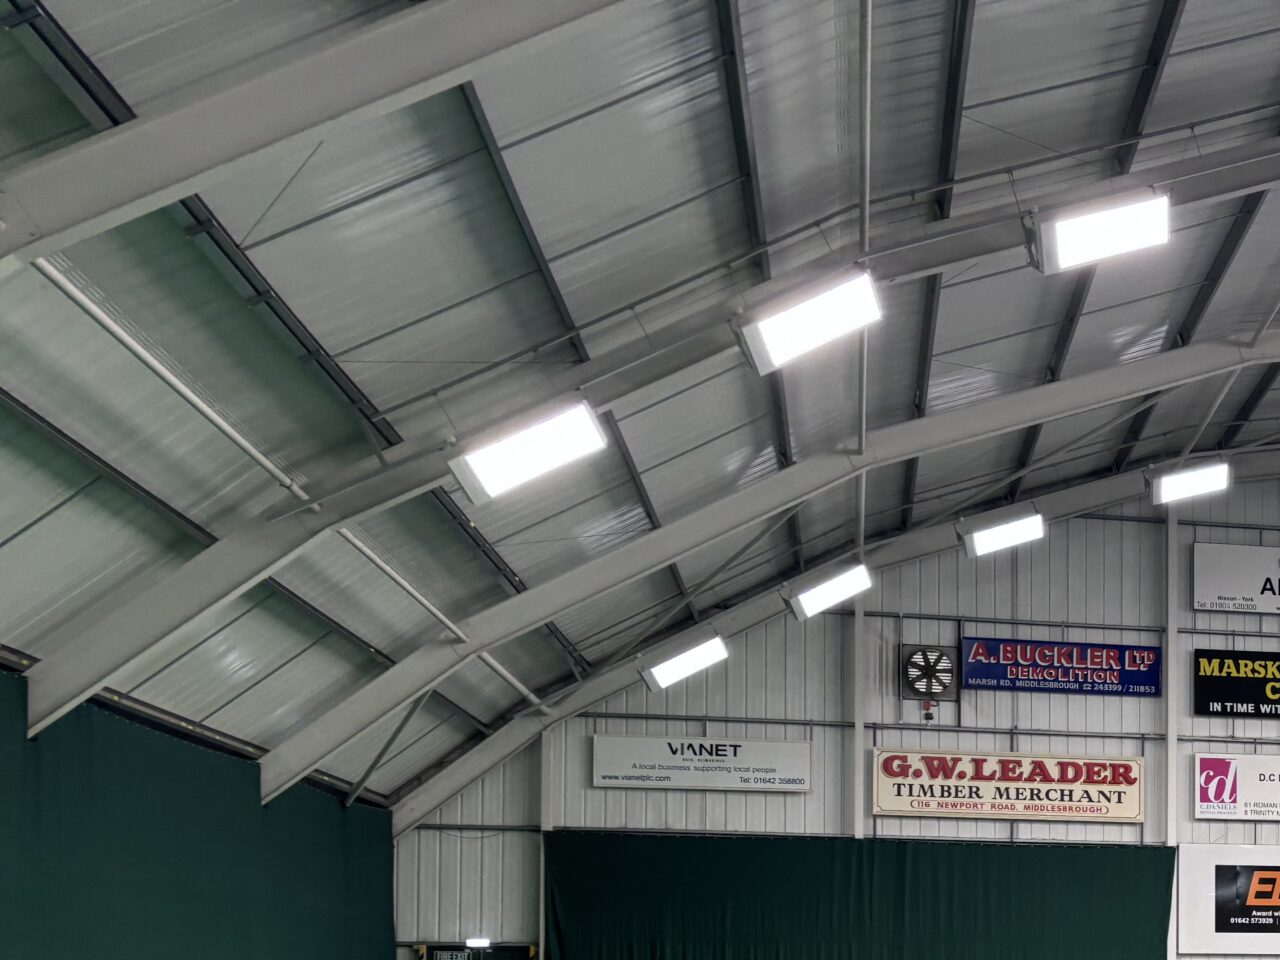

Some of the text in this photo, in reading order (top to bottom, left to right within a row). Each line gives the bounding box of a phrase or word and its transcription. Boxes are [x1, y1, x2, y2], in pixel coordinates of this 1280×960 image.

[1007, 665, 1120, 683] DEMOLITION
[968, 678, 997, 686] MARSH
[1015, 680, 1079, 690] MIDDLESBROUGH
[1209, 702, 1222, 712] IN
[1224, 702, 1255, 713] TIME
[667, 742, 742, 758] VIANET
[693, 765, 732, 774] supporting
[752, 767, 777, 775] people
[601, 774, 671, 782] www.vianetplc.com
[739, 776, 751, 784] Tel:
[778, 777, 805, 785] 358800
[1259, 773, 1276, 782] D.C
[892, 782, 1127, 804] TIMBER MERCHANT
[937, 801, 986, 809] NEWPORT
[437, 952, 469, 960] FIRE EXIT
